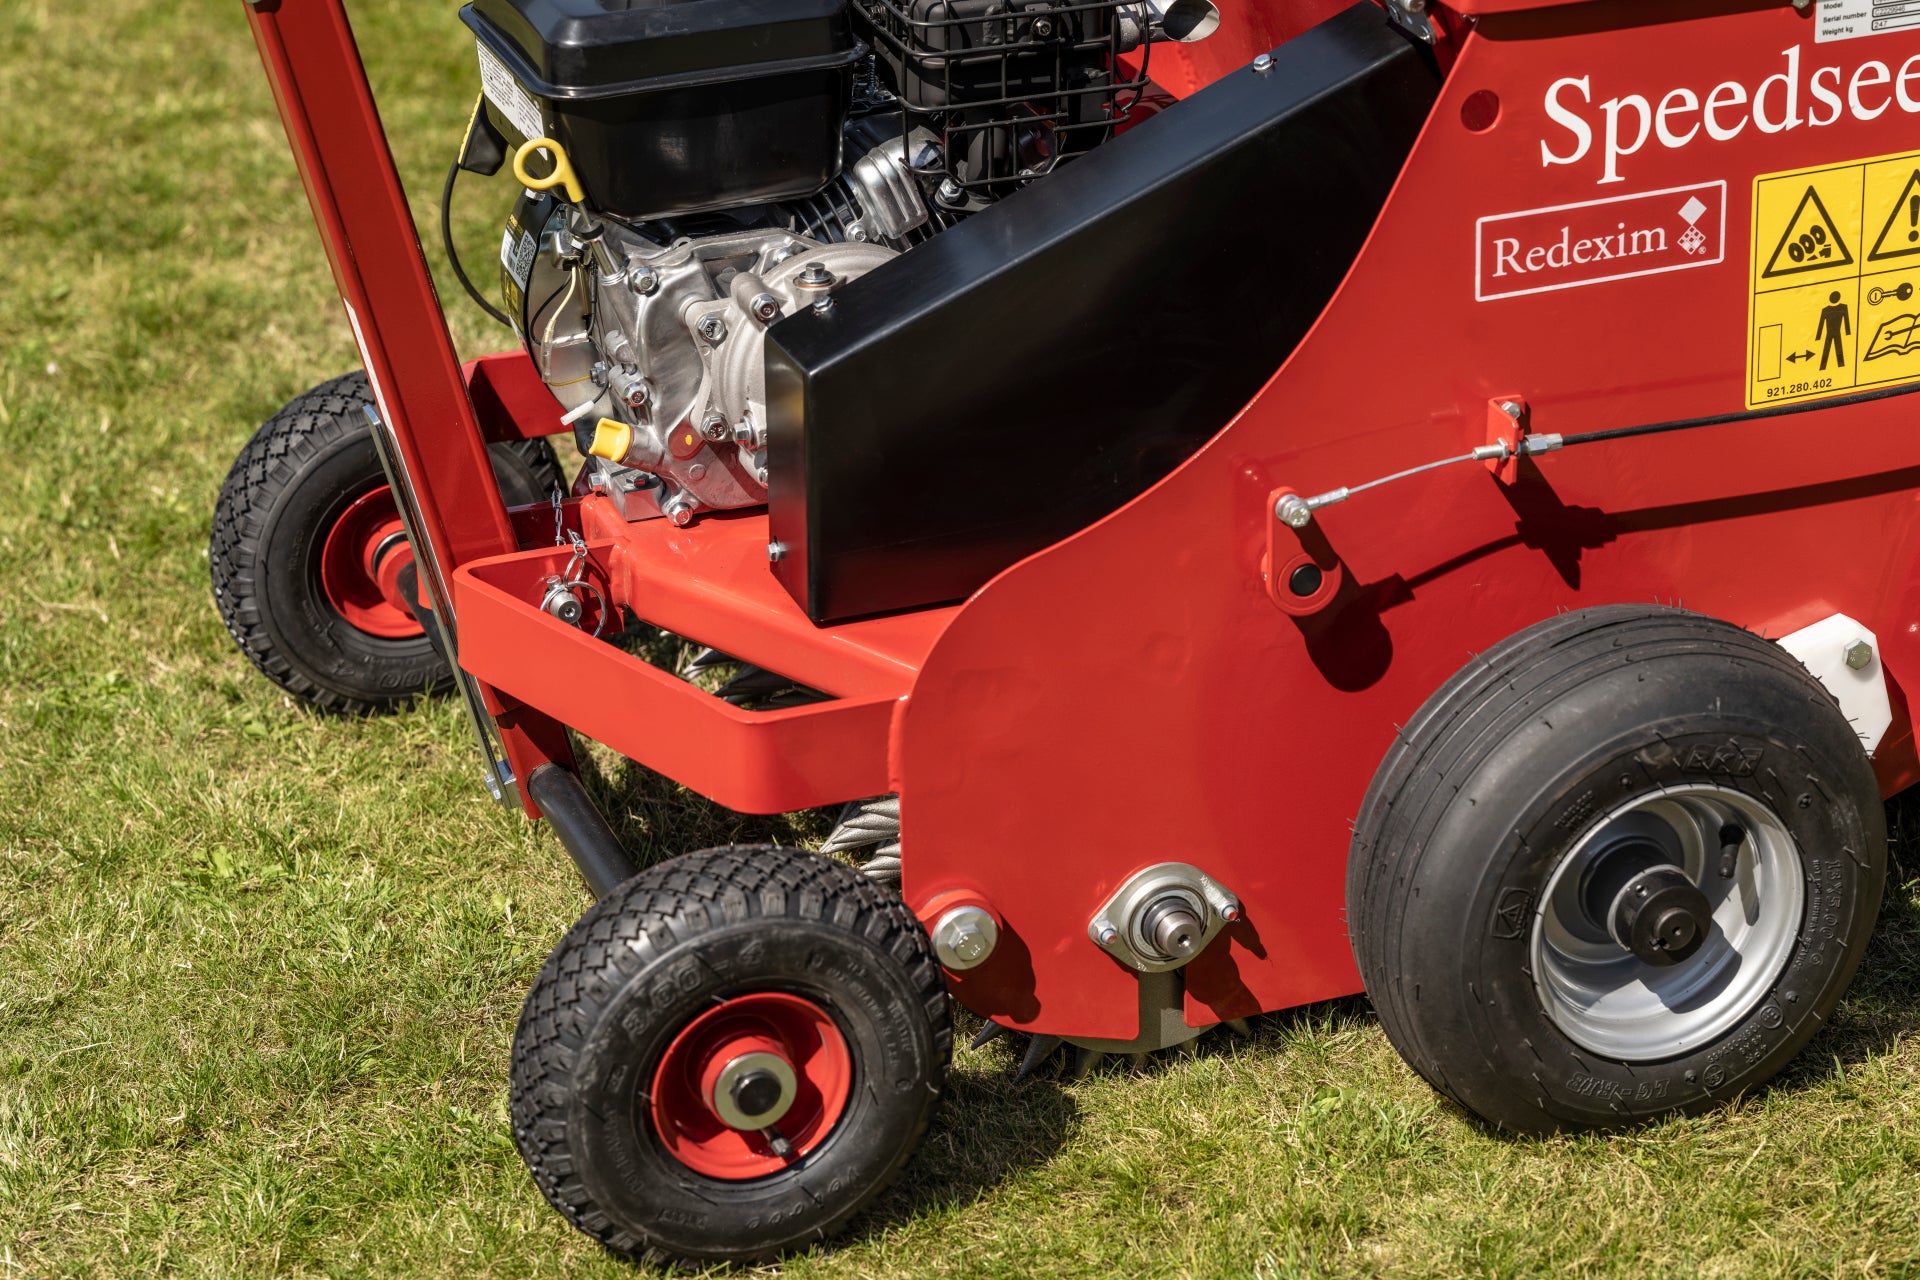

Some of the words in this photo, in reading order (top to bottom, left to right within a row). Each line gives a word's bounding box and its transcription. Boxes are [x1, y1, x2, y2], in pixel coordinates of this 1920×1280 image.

[1823, 2, 1843, 10] Model
[1823, 14, 1841, 23] Serial
[1842, 12, 1867, 20] number
[1874, 20, 1888, 29] 247
[1822, 28, 1844, 36] Weight
[1492, 222, 1668, 277] Redexim
[1767, 378, 1832, 398] 921.280.402
